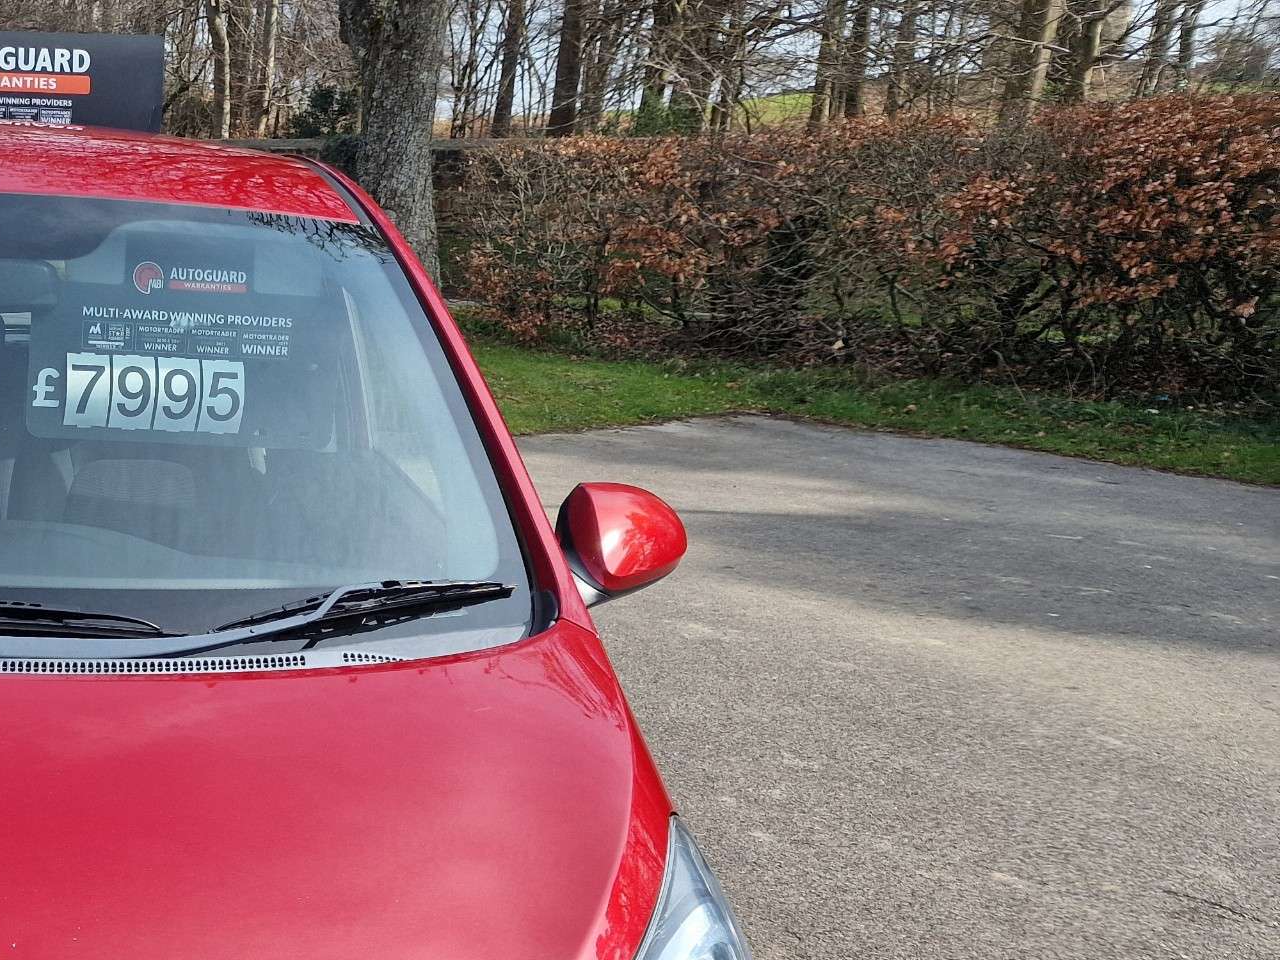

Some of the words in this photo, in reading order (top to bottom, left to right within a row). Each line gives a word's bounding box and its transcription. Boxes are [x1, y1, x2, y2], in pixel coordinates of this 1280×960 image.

[31, 98, 73, 107] PROVIDERS
[170, 267, 247, 284] AUTOGUARD
[183, 282, 232, 291] WARRANTIES
[82, 306, 168, 321] MULTI-AWARD
[169, 311, 225, 325] WINNING
[227, 315, 293, 328] PROVIDERS
[242, 333, 289, 341] MOTORTRADER
[144, 342, 177, 352] WINNER
[196, 344, 229, 354] WINNER
[241, 343, 288, 356] WINNER
